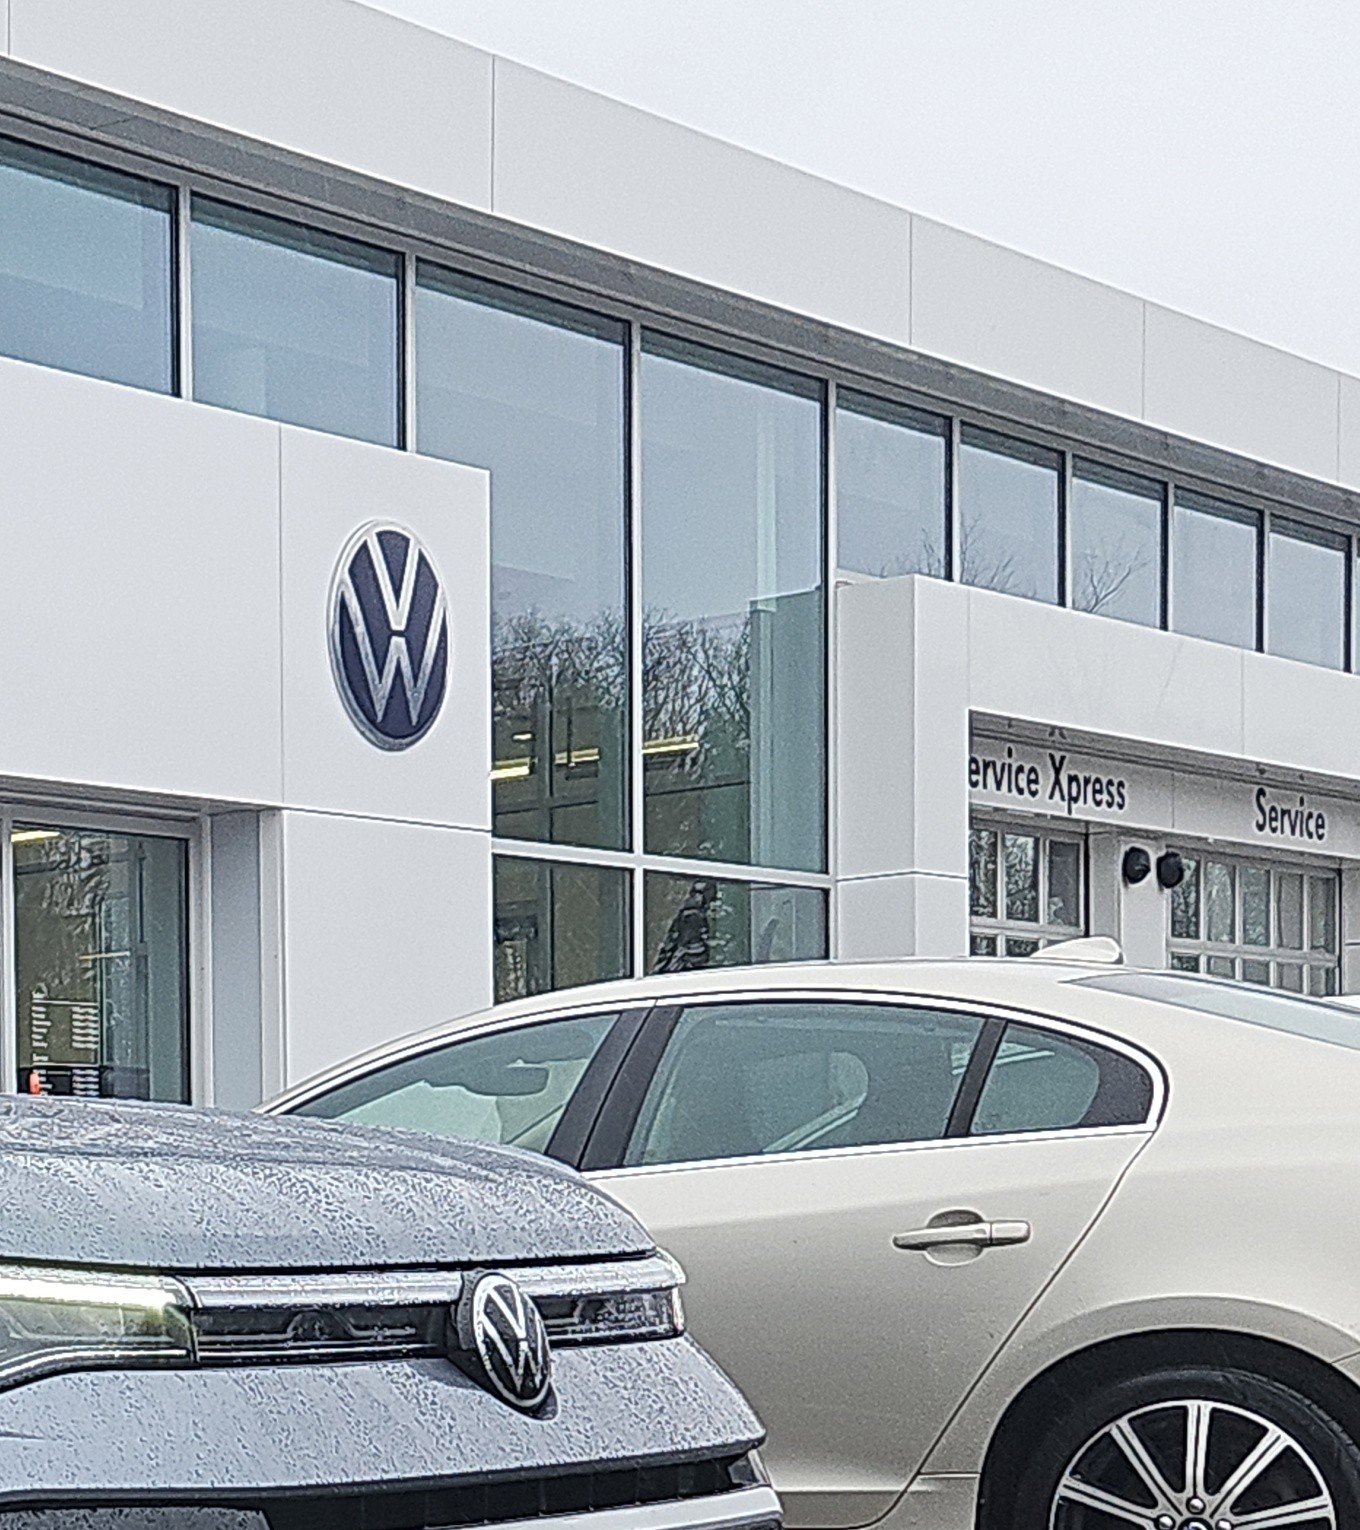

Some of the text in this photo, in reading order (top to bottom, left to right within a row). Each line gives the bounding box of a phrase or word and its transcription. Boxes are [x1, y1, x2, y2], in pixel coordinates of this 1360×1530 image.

[968, 747, 1127, 815] ervice Xpress
[1255, 787, 1327, 841] Service
